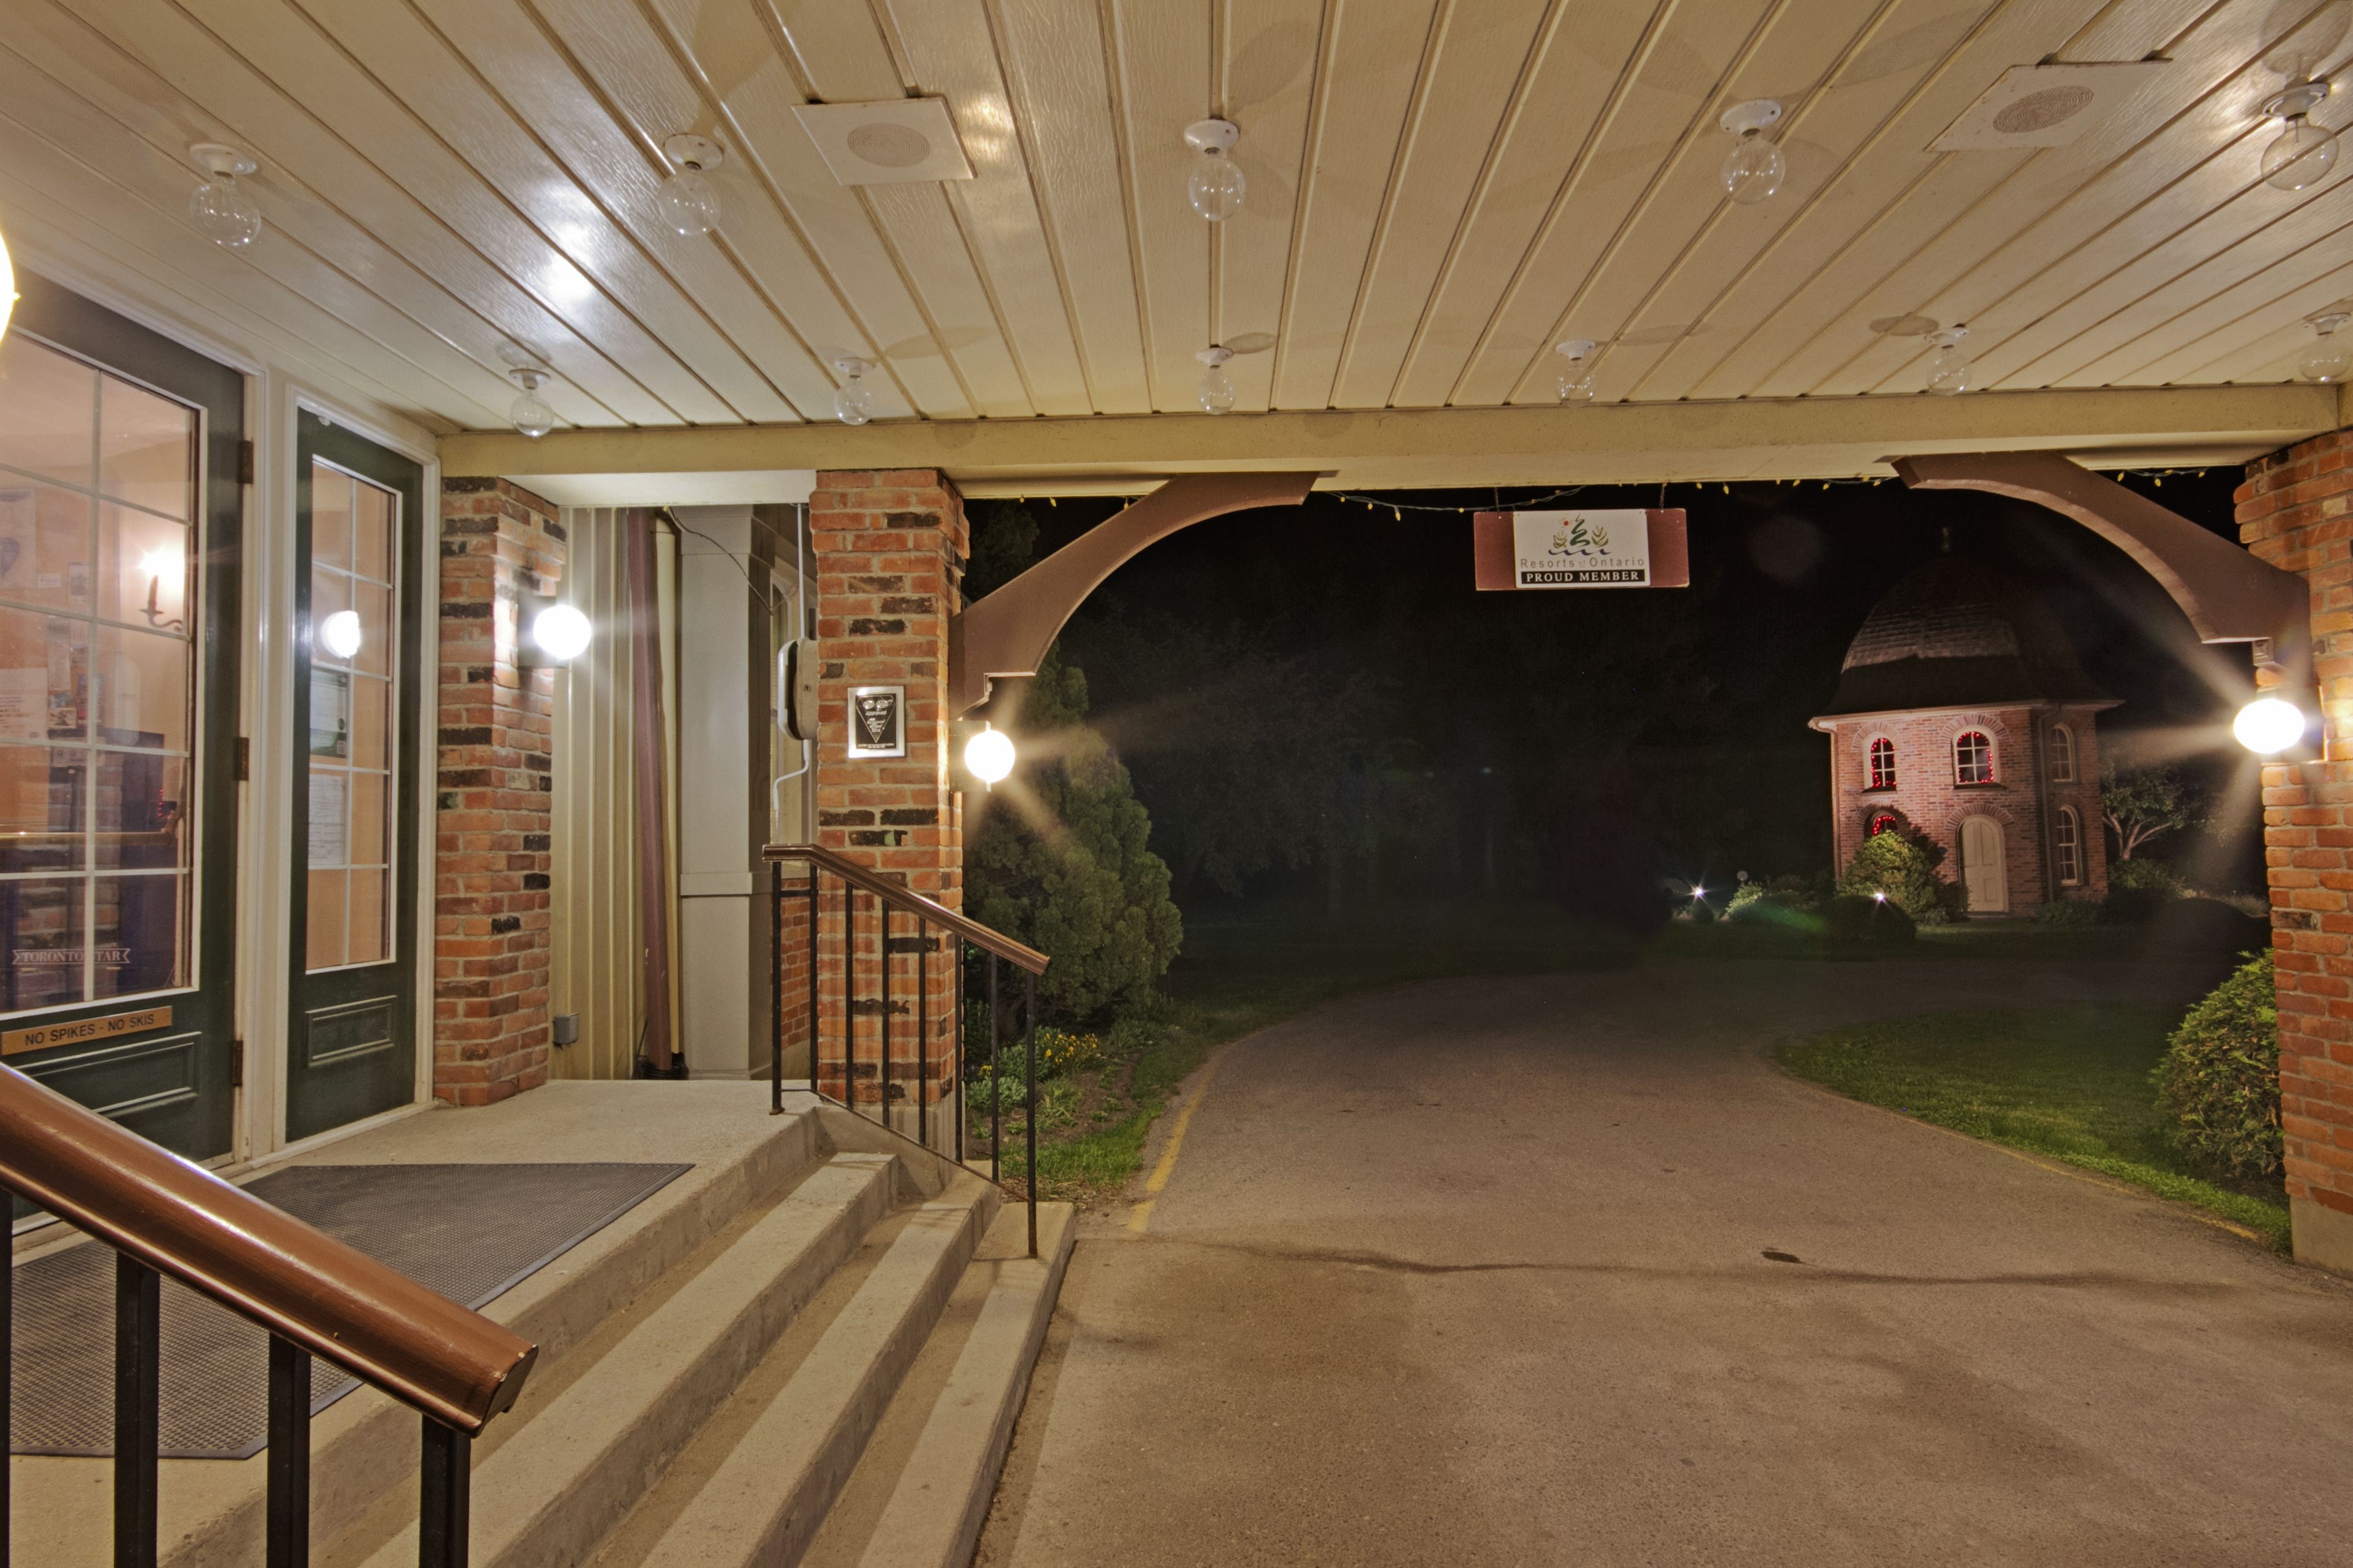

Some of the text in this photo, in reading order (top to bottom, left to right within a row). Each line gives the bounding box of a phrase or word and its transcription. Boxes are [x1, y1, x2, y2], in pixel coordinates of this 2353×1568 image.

[1521, 558, 1575, 568] Resorts
[1589, 556, 1645, 567] Ontario
[1526, 571, 1639, 582] PROUD MEMBER
[21, 950, 120, 962] TORONTO TAR
[25, 1032, 45, 1046] NO
[50, 1024, 95, 1042] SPIKES
[108, 1019, 125, 1032] NO
[130, 1014, 154, 1028] SKIS
